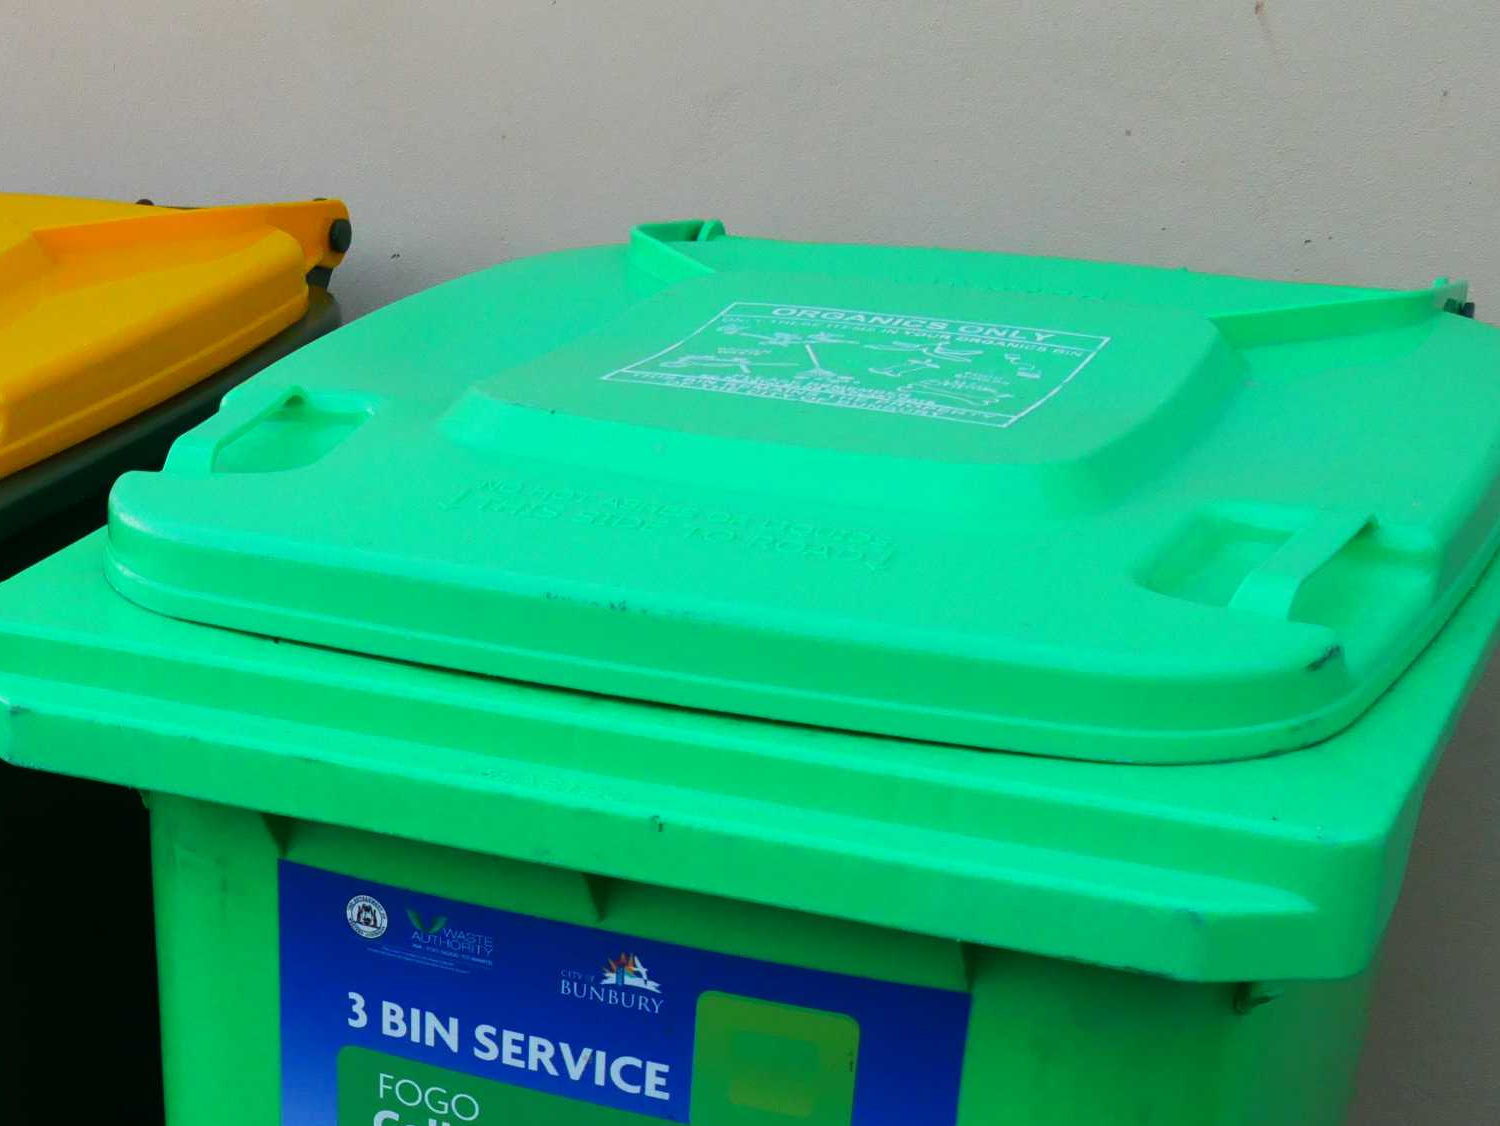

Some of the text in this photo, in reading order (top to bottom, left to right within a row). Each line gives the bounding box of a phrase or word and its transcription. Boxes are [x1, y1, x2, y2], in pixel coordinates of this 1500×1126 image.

[772, 307, 1055, 343] ORGANICS ONLY
[411, 930, 493, 957] AUTHORITY
[441, 926, 493, 947] WASTE
[560, 979, 665, 1014] BUNBURY
[347, 991, 672, 1101] 3 BIN SERVICE
[378, 1073, 480, 1123] FOGO
